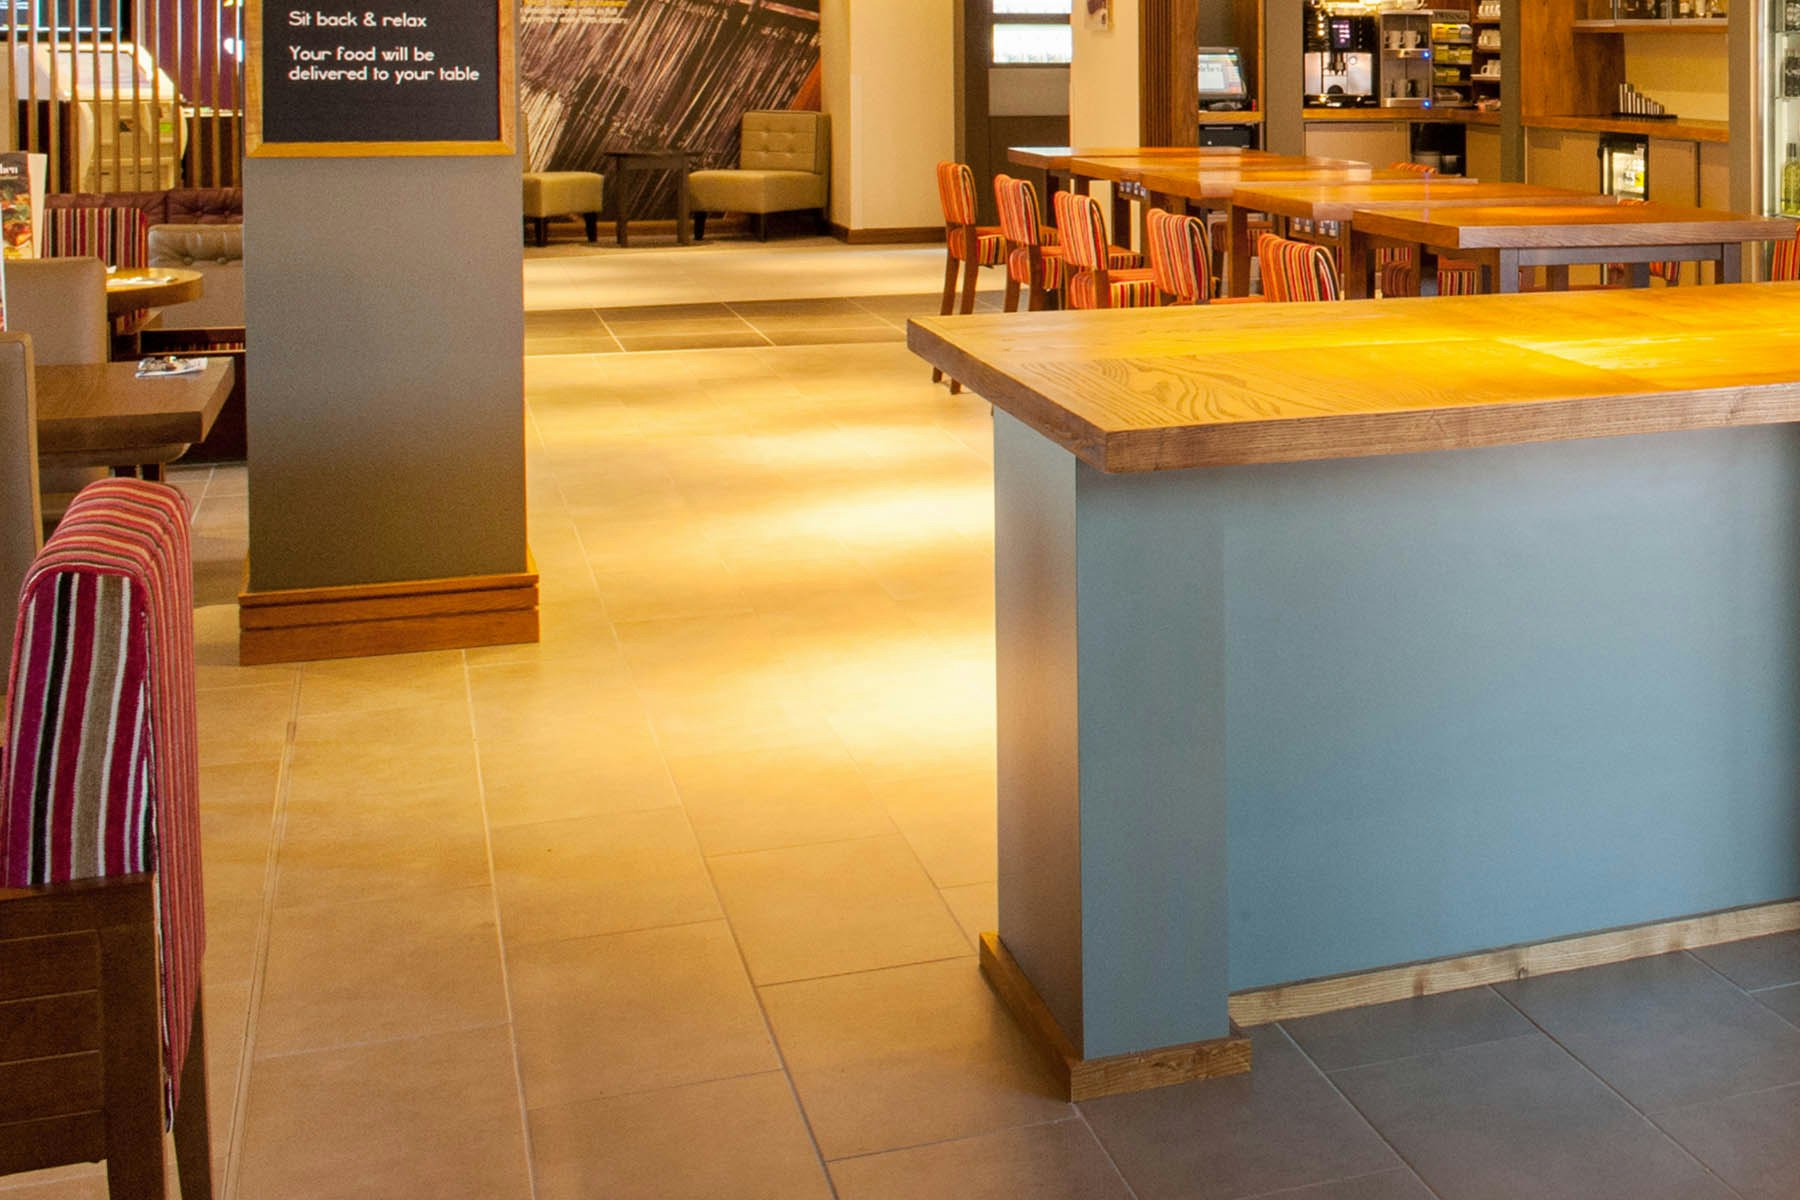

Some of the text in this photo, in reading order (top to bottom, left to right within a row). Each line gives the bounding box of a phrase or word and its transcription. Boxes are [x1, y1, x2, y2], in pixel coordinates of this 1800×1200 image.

[288, 11, 427, 27] Sit back & relax
[289, 46, 435, 61] Your food will be
[288, 65, 480, 85] delivered to your table
